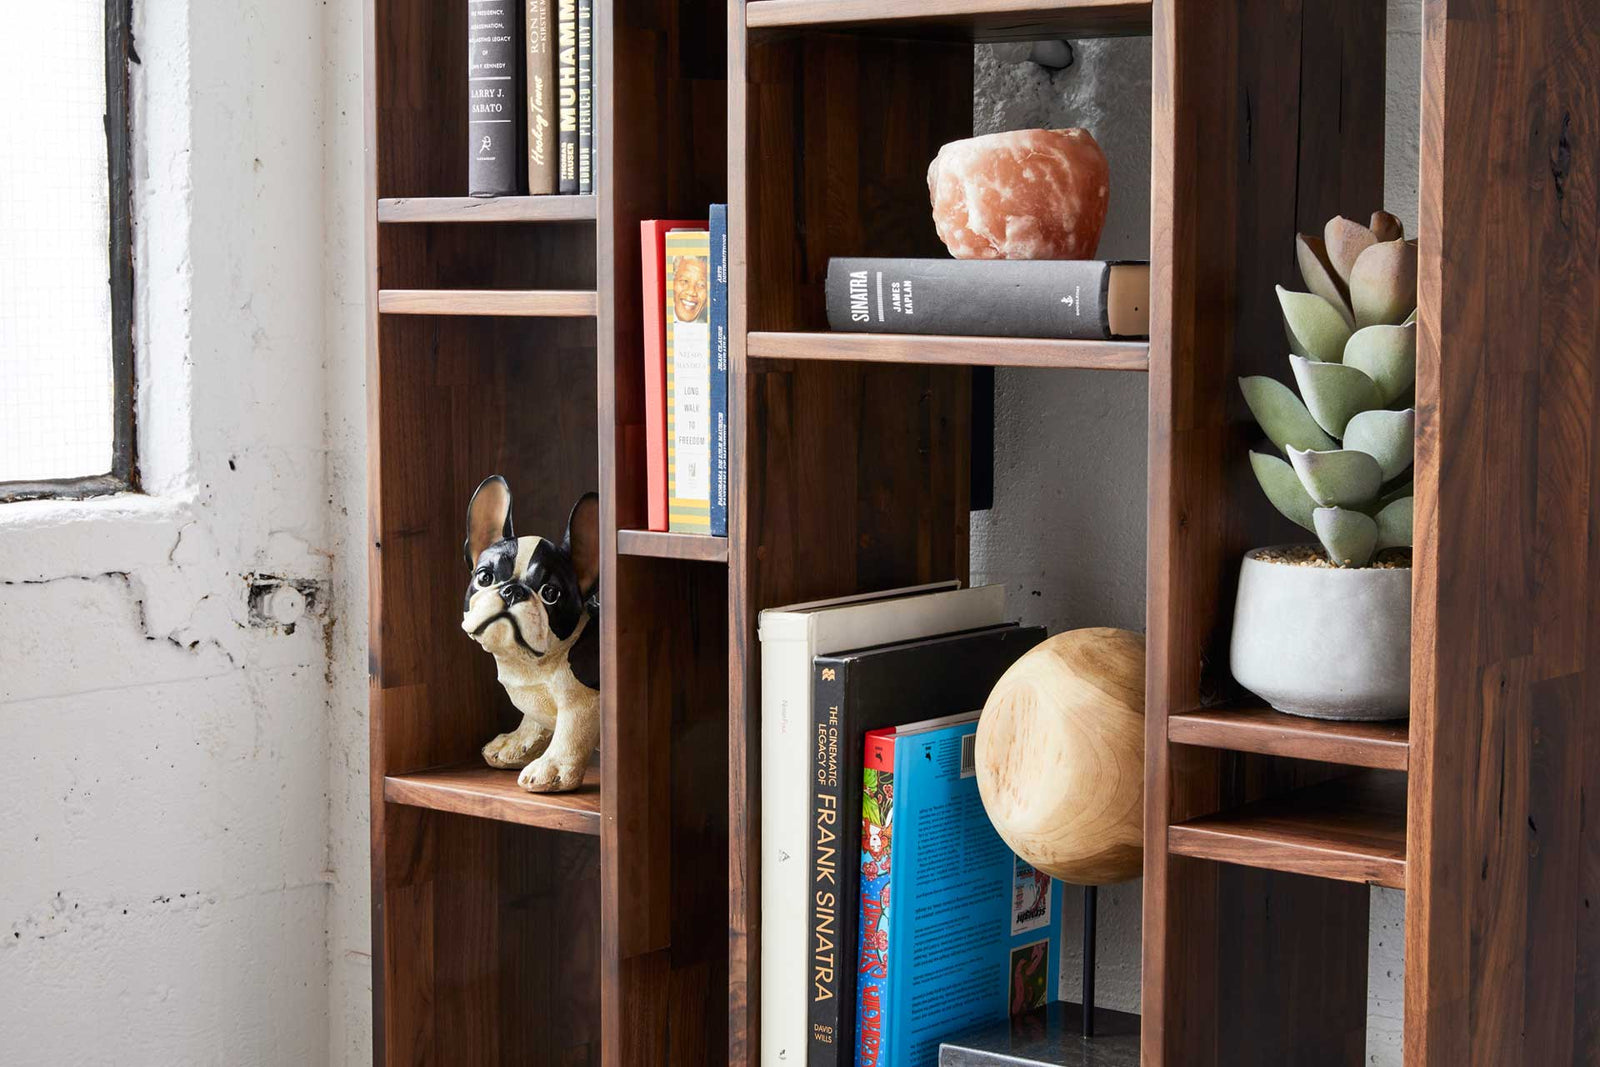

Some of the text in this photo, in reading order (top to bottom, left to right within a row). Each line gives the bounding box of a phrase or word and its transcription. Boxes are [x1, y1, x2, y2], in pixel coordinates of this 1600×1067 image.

[579, 6, 590, 18] OF
[530, 18, 539, 53] RON
[579, 26, 590, 47] RAY
[559, 0, 576, 132] MUHAMM
[579, 68, 590, 81] BY
[471, 88, 504, 98] LARRY J.
[472, 103, 502, 113] SABATO
[530, 75, 548, 166] Hockey Towns
[579, 88, 590, 136] PIERCED
[579, 147, 590, 184] GORDON
[851, 270, 870, 322] SINATRA
[892, 282, 901, 312] JAMES
[903, 280, 913, 314] KAPLAN
[684, 386, 700, 396] LONG
[684, 404, 699, 412] WALK
[689, 420, 696, 430] TO
[679, 436, 705, 446] FREEDOM
[817, 723, 826, 785] LEGACY OF
[828, 705, 838, 787] THE CINEMATIC
[815, 793, 836, 1002] FRANK SINATRA
[814, 1024, 833, 1034] DAVID
[814, 1033, 833, 1044] WILLS
